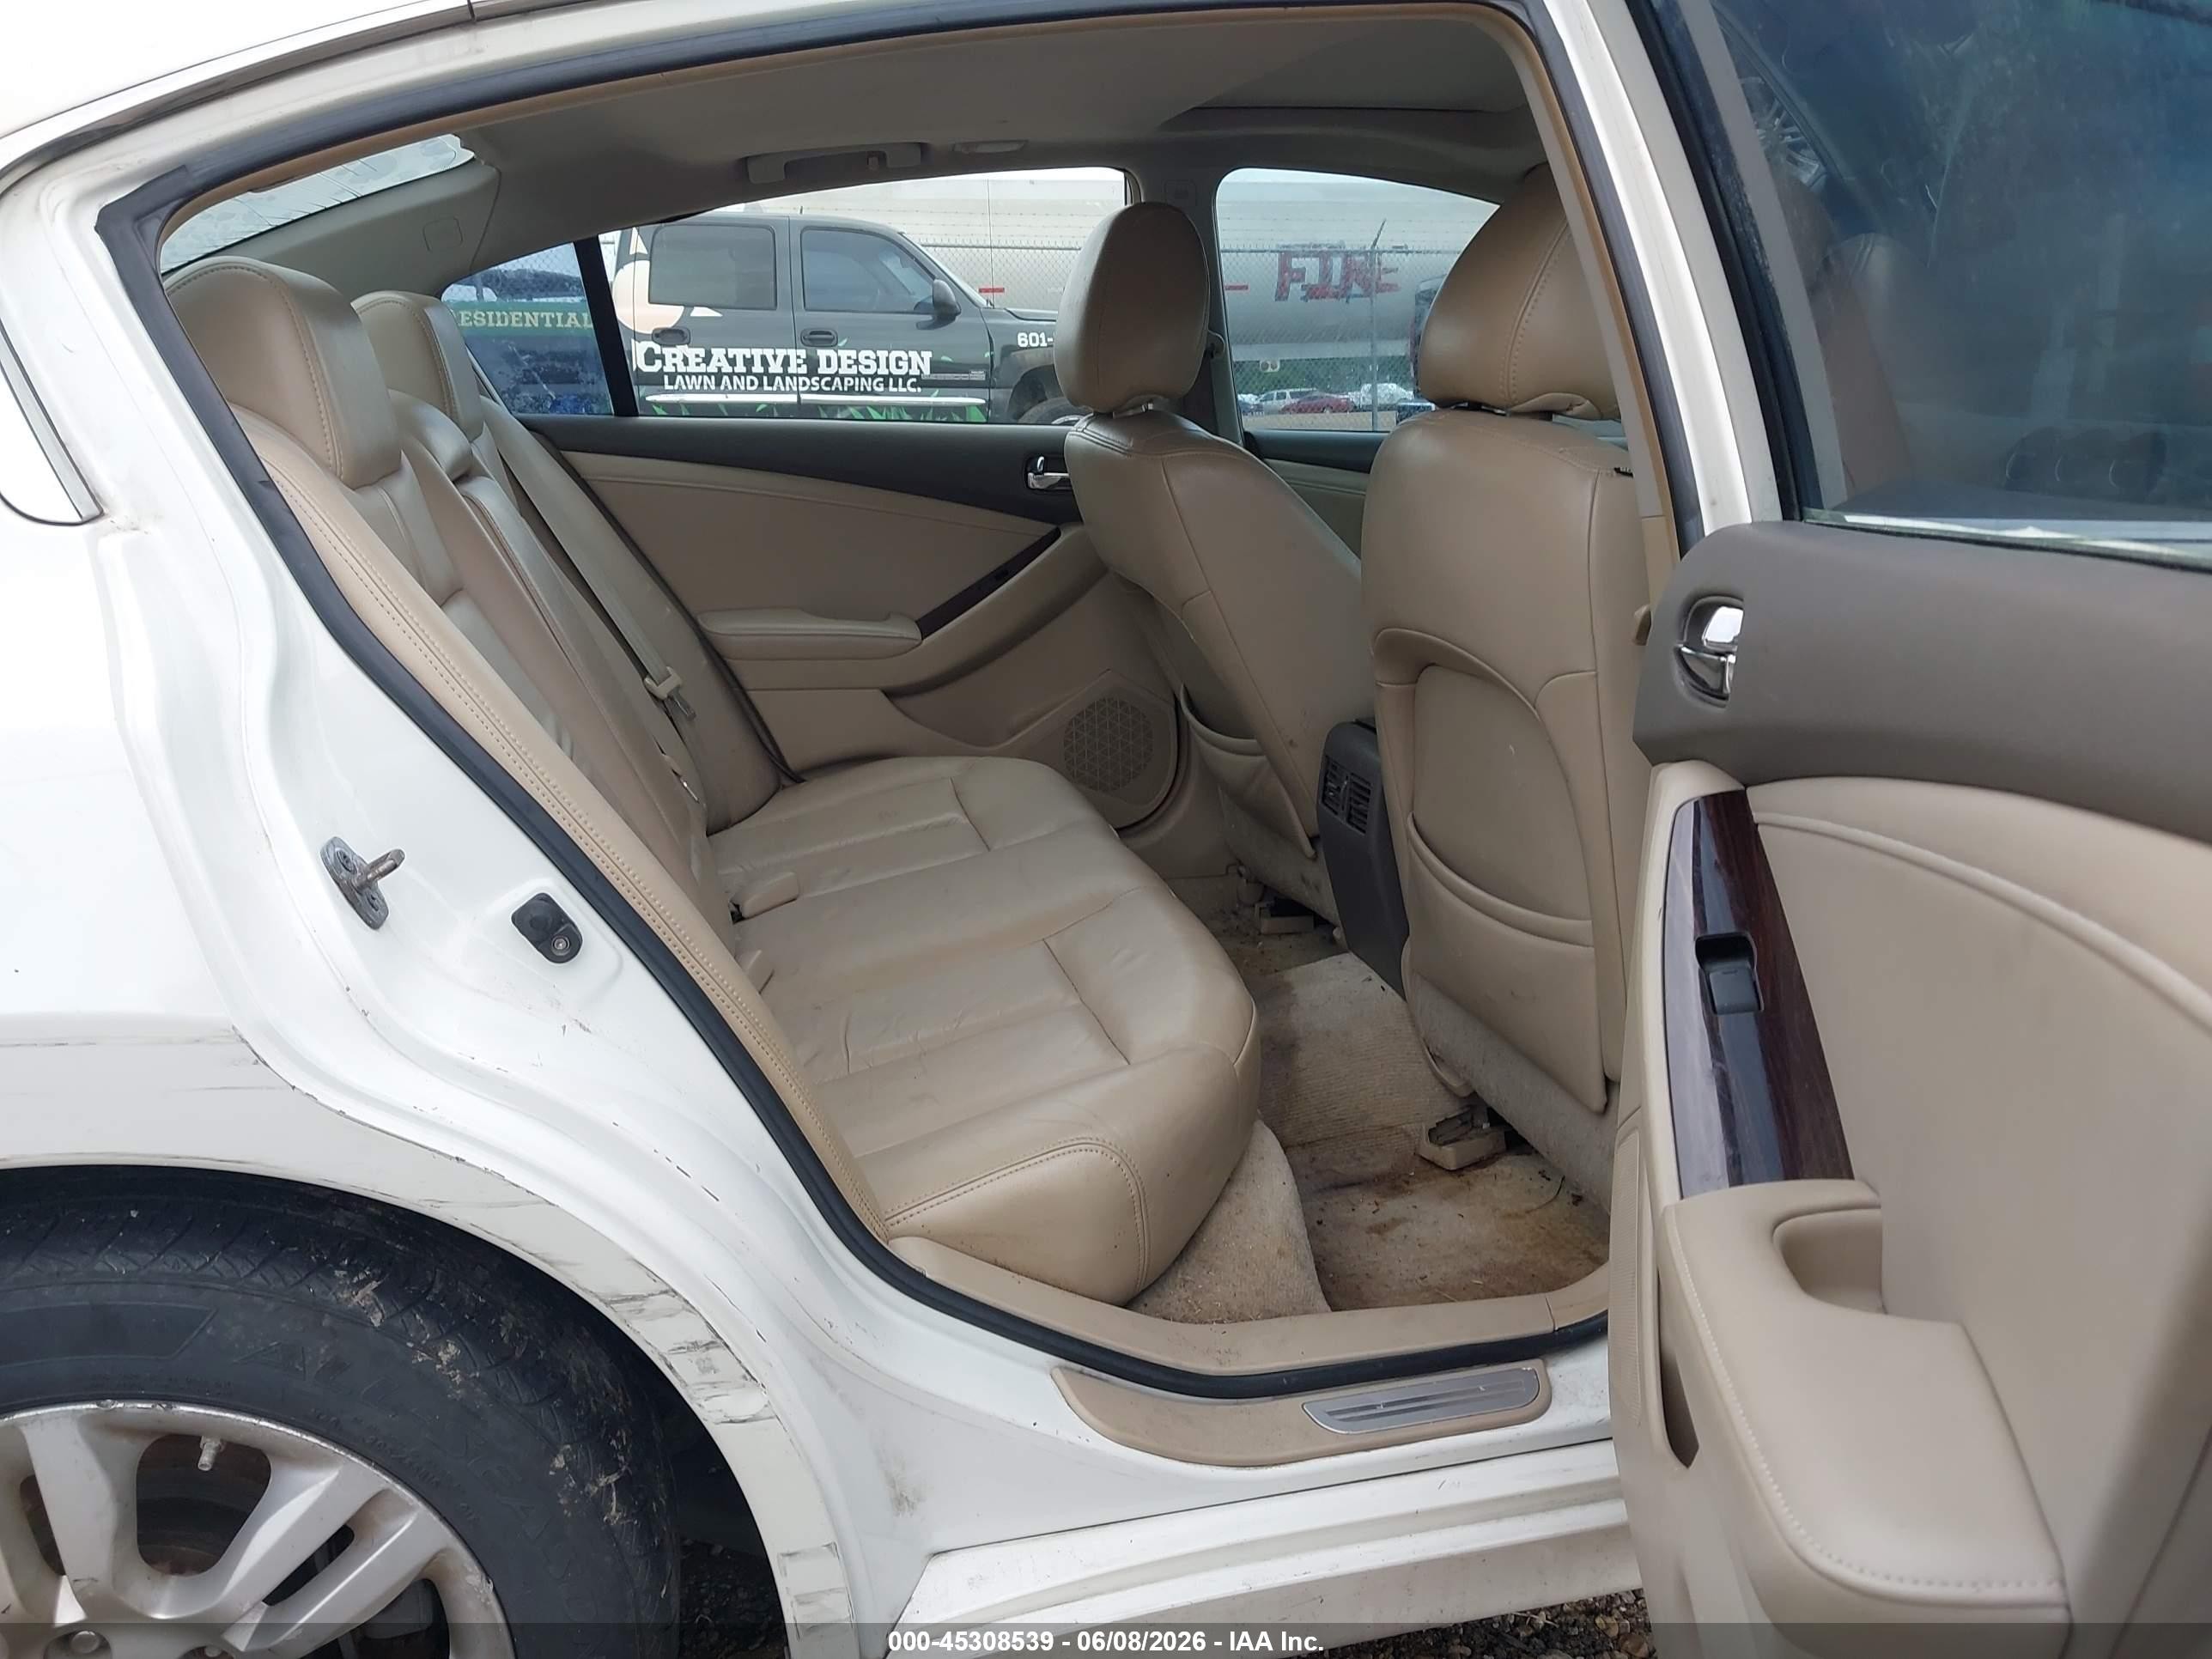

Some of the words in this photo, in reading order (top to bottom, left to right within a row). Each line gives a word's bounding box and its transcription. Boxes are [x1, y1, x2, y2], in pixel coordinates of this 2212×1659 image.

[458, 310, 592, 329] ESIDENTIAL
[635, 340, 808, 374] CREATIVE
[817, 349, 933, 375] DESIGN
[664, 374, 715, 390] LAWN
[720, 375, 759, 391] AND
[763, 376, 884, 392] LANDSCAPING
